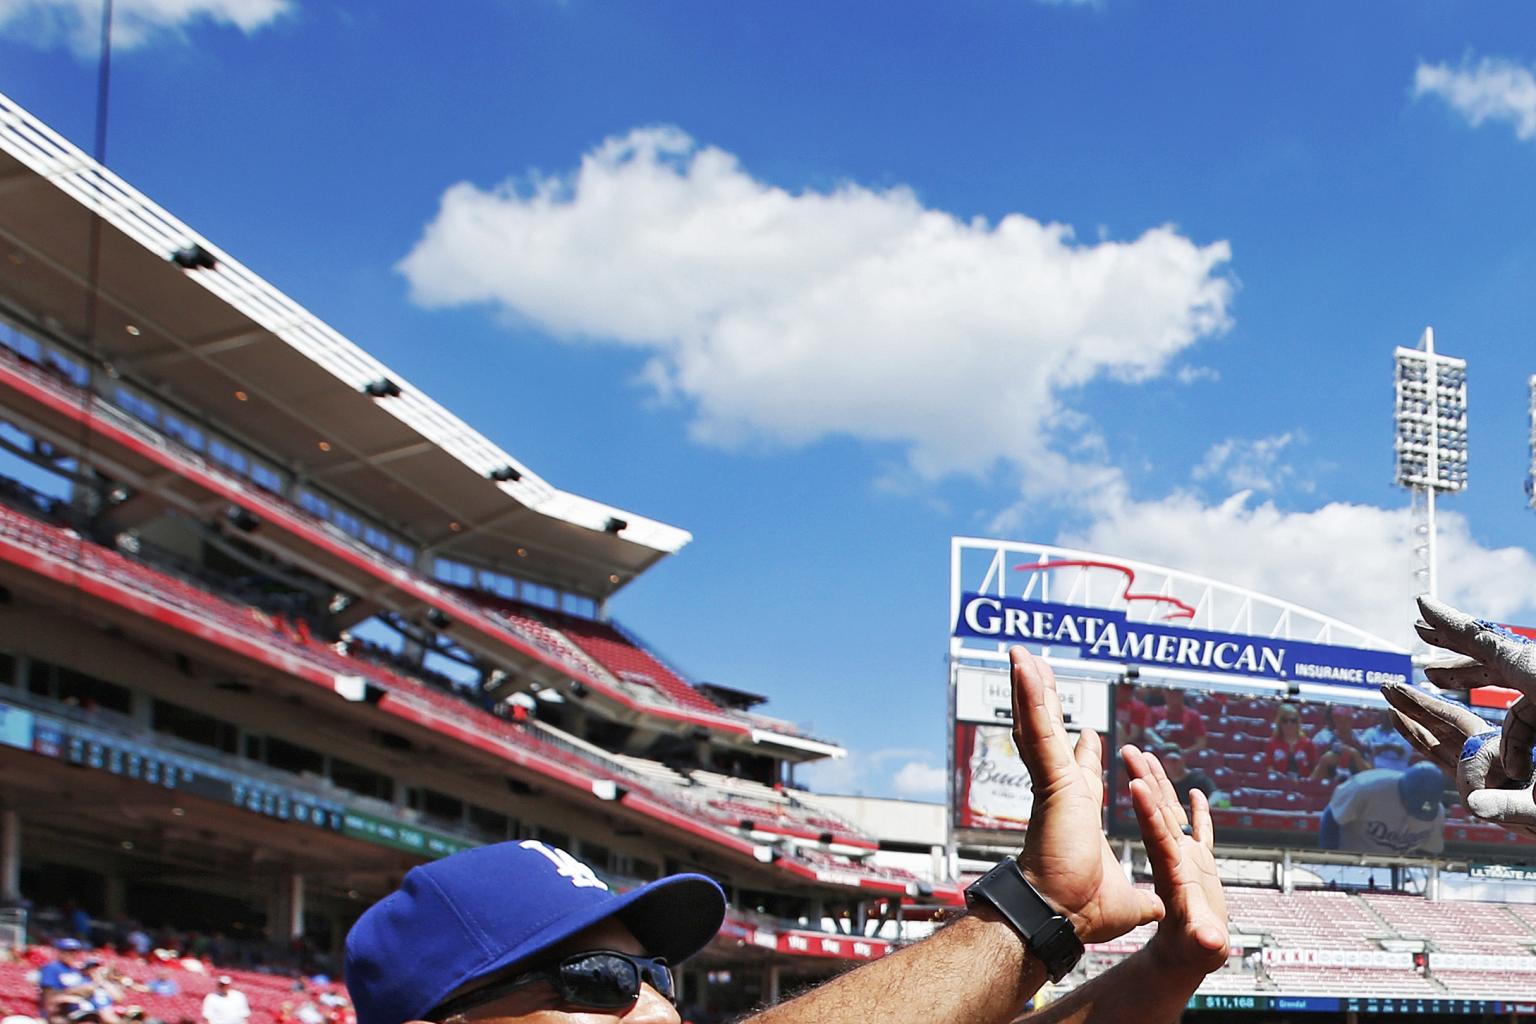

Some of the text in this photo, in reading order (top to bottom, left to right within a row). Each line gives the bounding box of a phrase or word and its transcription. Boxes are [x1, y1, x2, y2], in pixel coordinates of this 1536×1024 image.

[1295, 663, 1364, 683] INSURANCE
[1366, 671, 1406, 685] GROUP
[518, 839, 608, 891] LA
